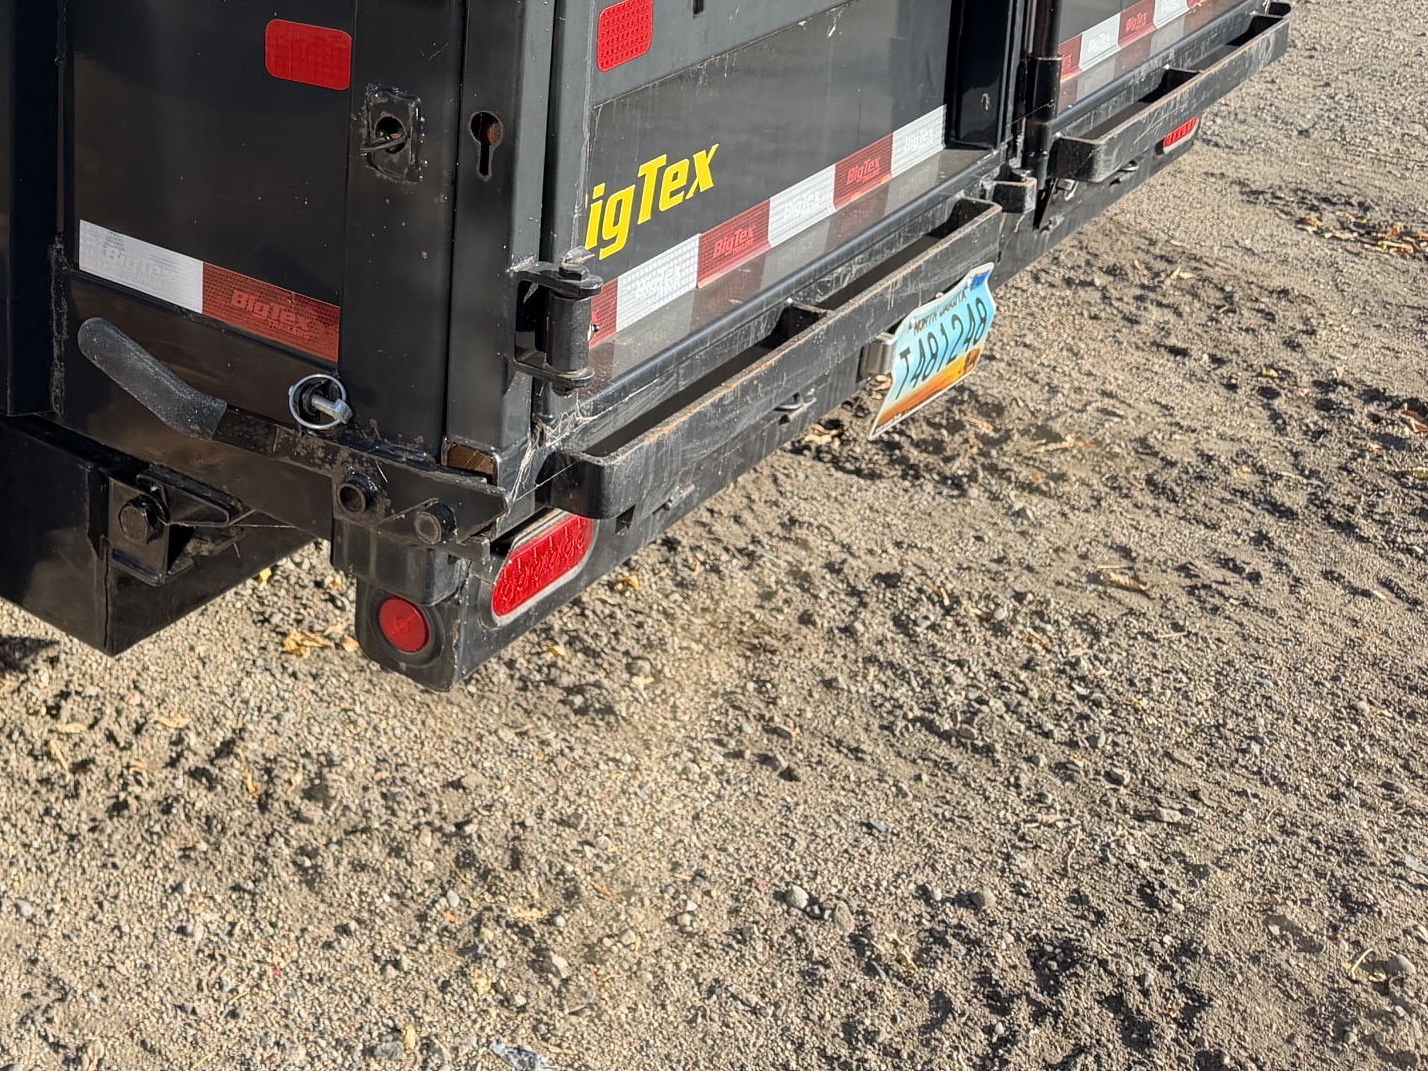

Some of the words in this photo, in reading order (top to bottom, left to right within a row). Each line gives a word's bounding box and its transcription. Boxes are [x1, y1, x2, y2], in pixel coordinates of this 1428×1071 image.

[846, 155, 881, 186] BigTex
[585, 143, 720, 261] igTex
[713, 225, 756, 259] BigTex
[231, 289, 312, 331] BigTex
[895, 296, 988, 400] T481248
